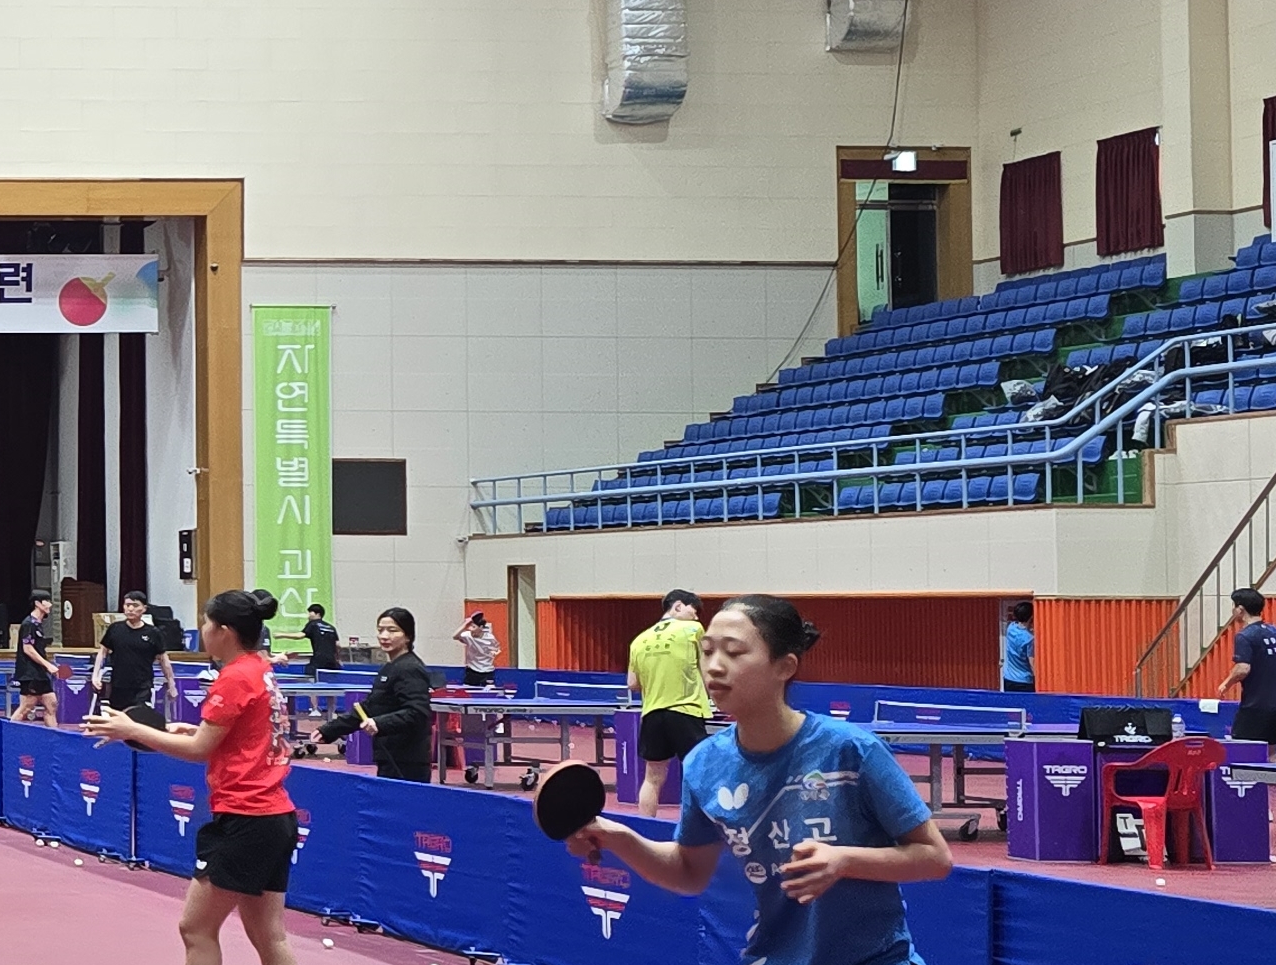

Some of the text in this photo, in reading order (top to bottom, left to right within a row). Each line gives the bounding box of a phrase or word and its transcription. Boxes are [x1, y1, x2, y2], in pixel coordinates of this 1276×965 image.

[276, 549, 319, 618] 괴산
[1043, 765, 1088, 775] TAGRO
[725, 817, 837, 857] 정산고
